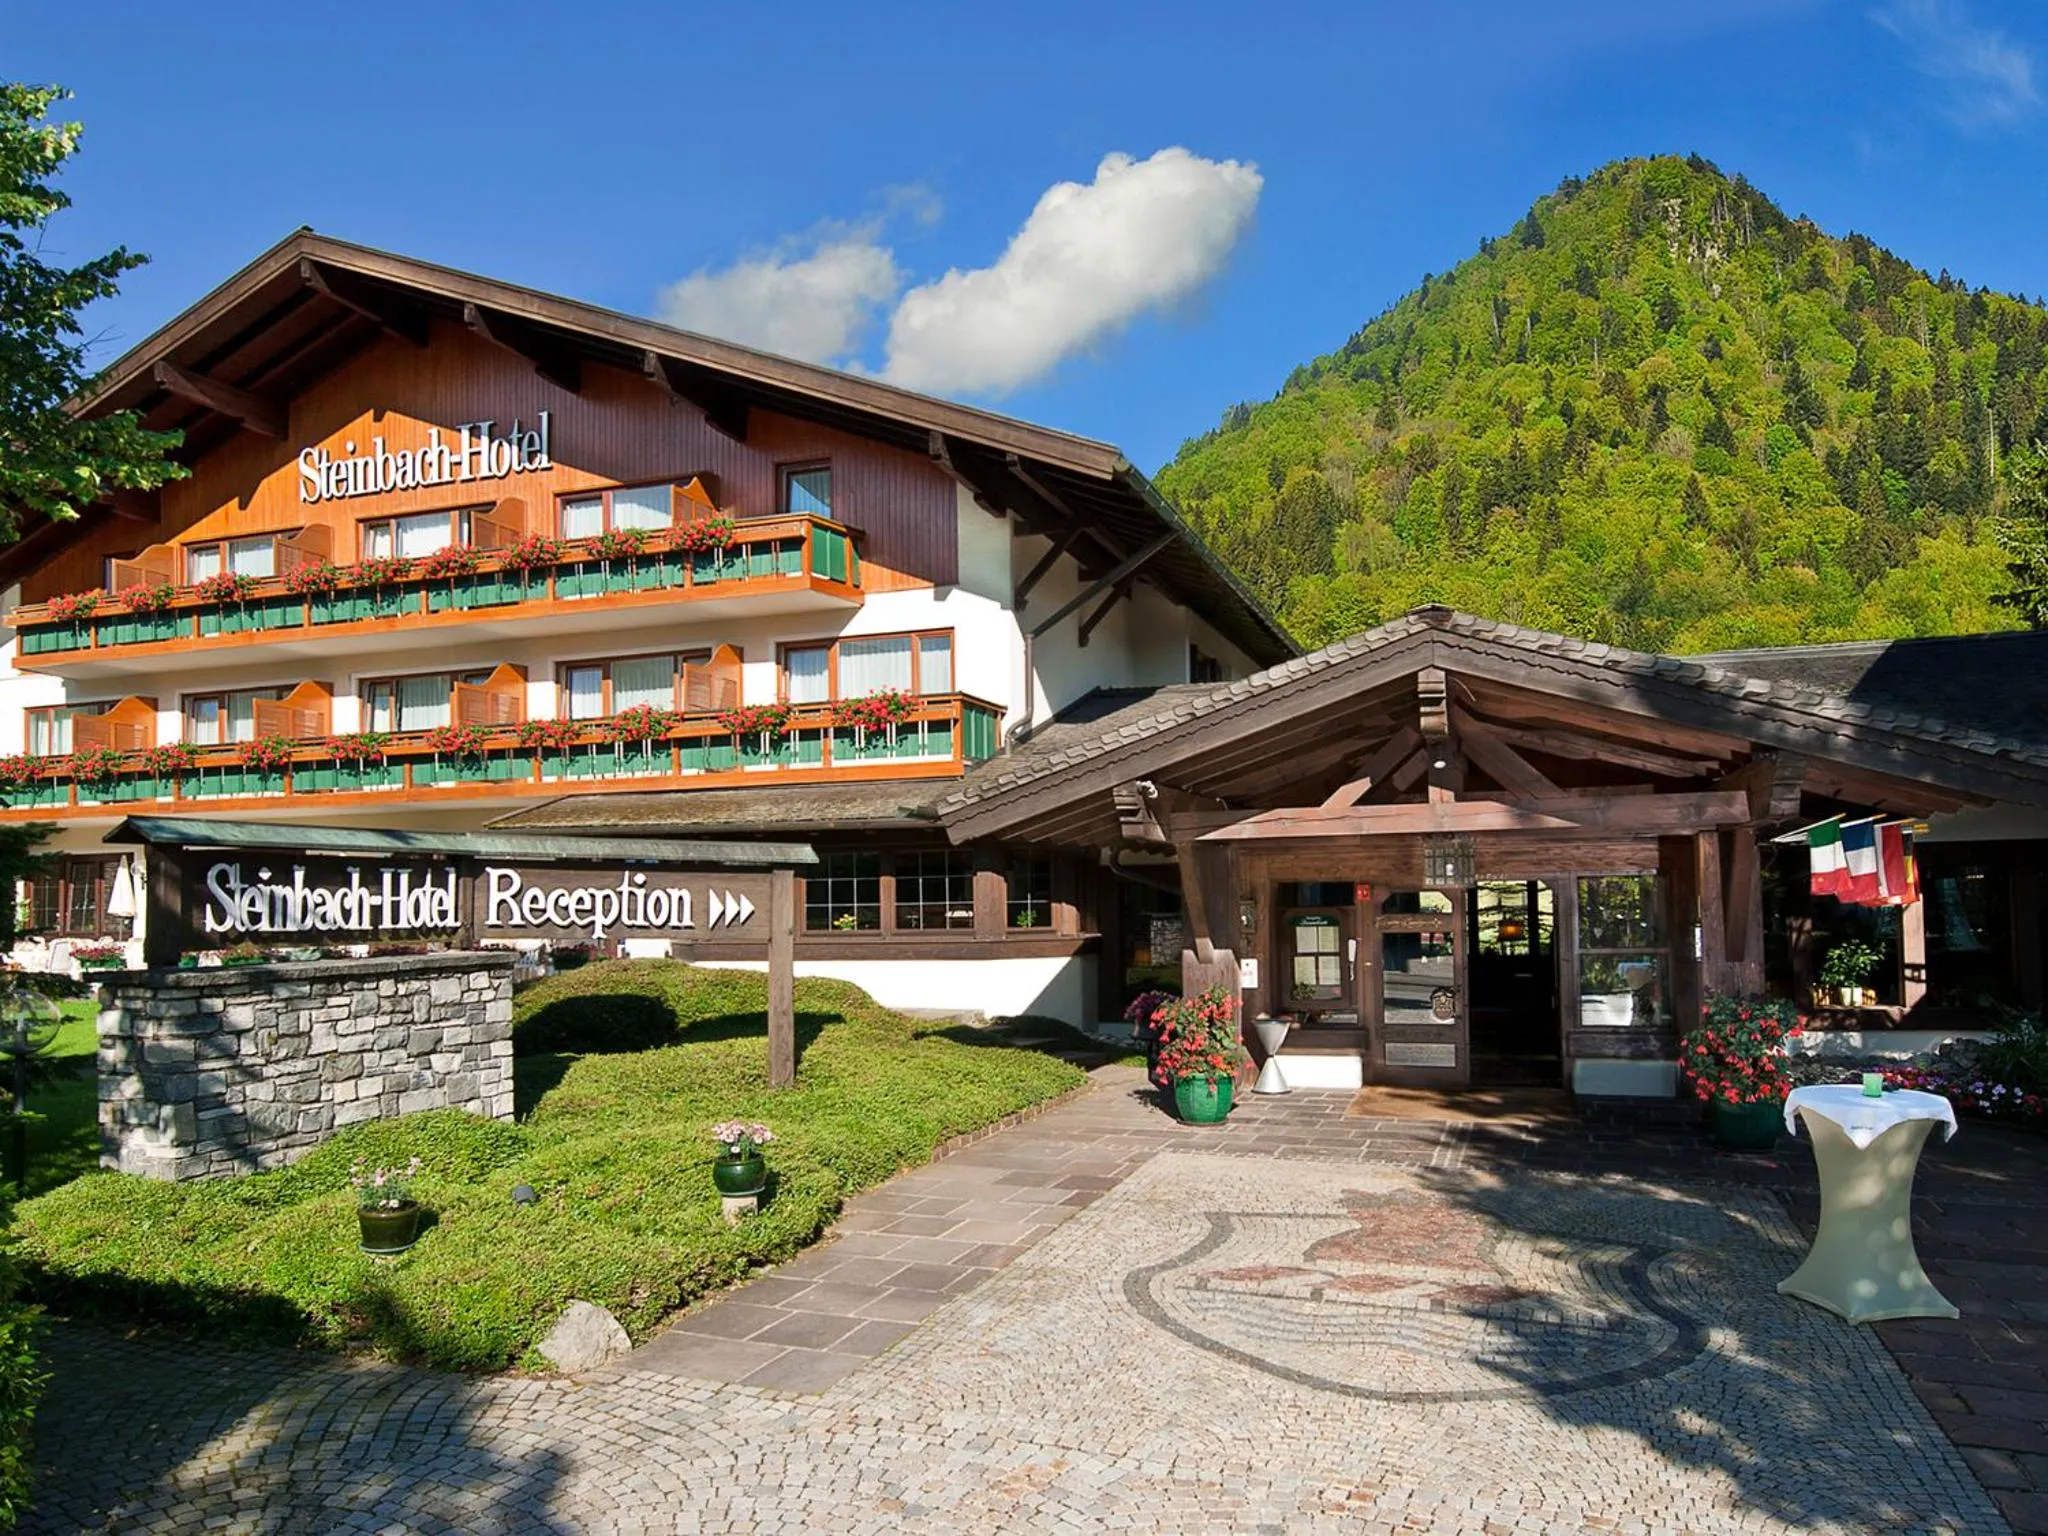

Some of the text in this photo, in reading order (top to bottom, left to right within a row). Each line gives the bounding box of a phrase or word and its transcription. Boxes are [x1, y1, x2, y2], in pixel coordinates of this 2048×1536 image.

[300, 411, 552, 502] Steinbach-Hotel
[205, 863, 461, 932] Steinbach-Hotel
[485, 866, 694, 939] Reception
